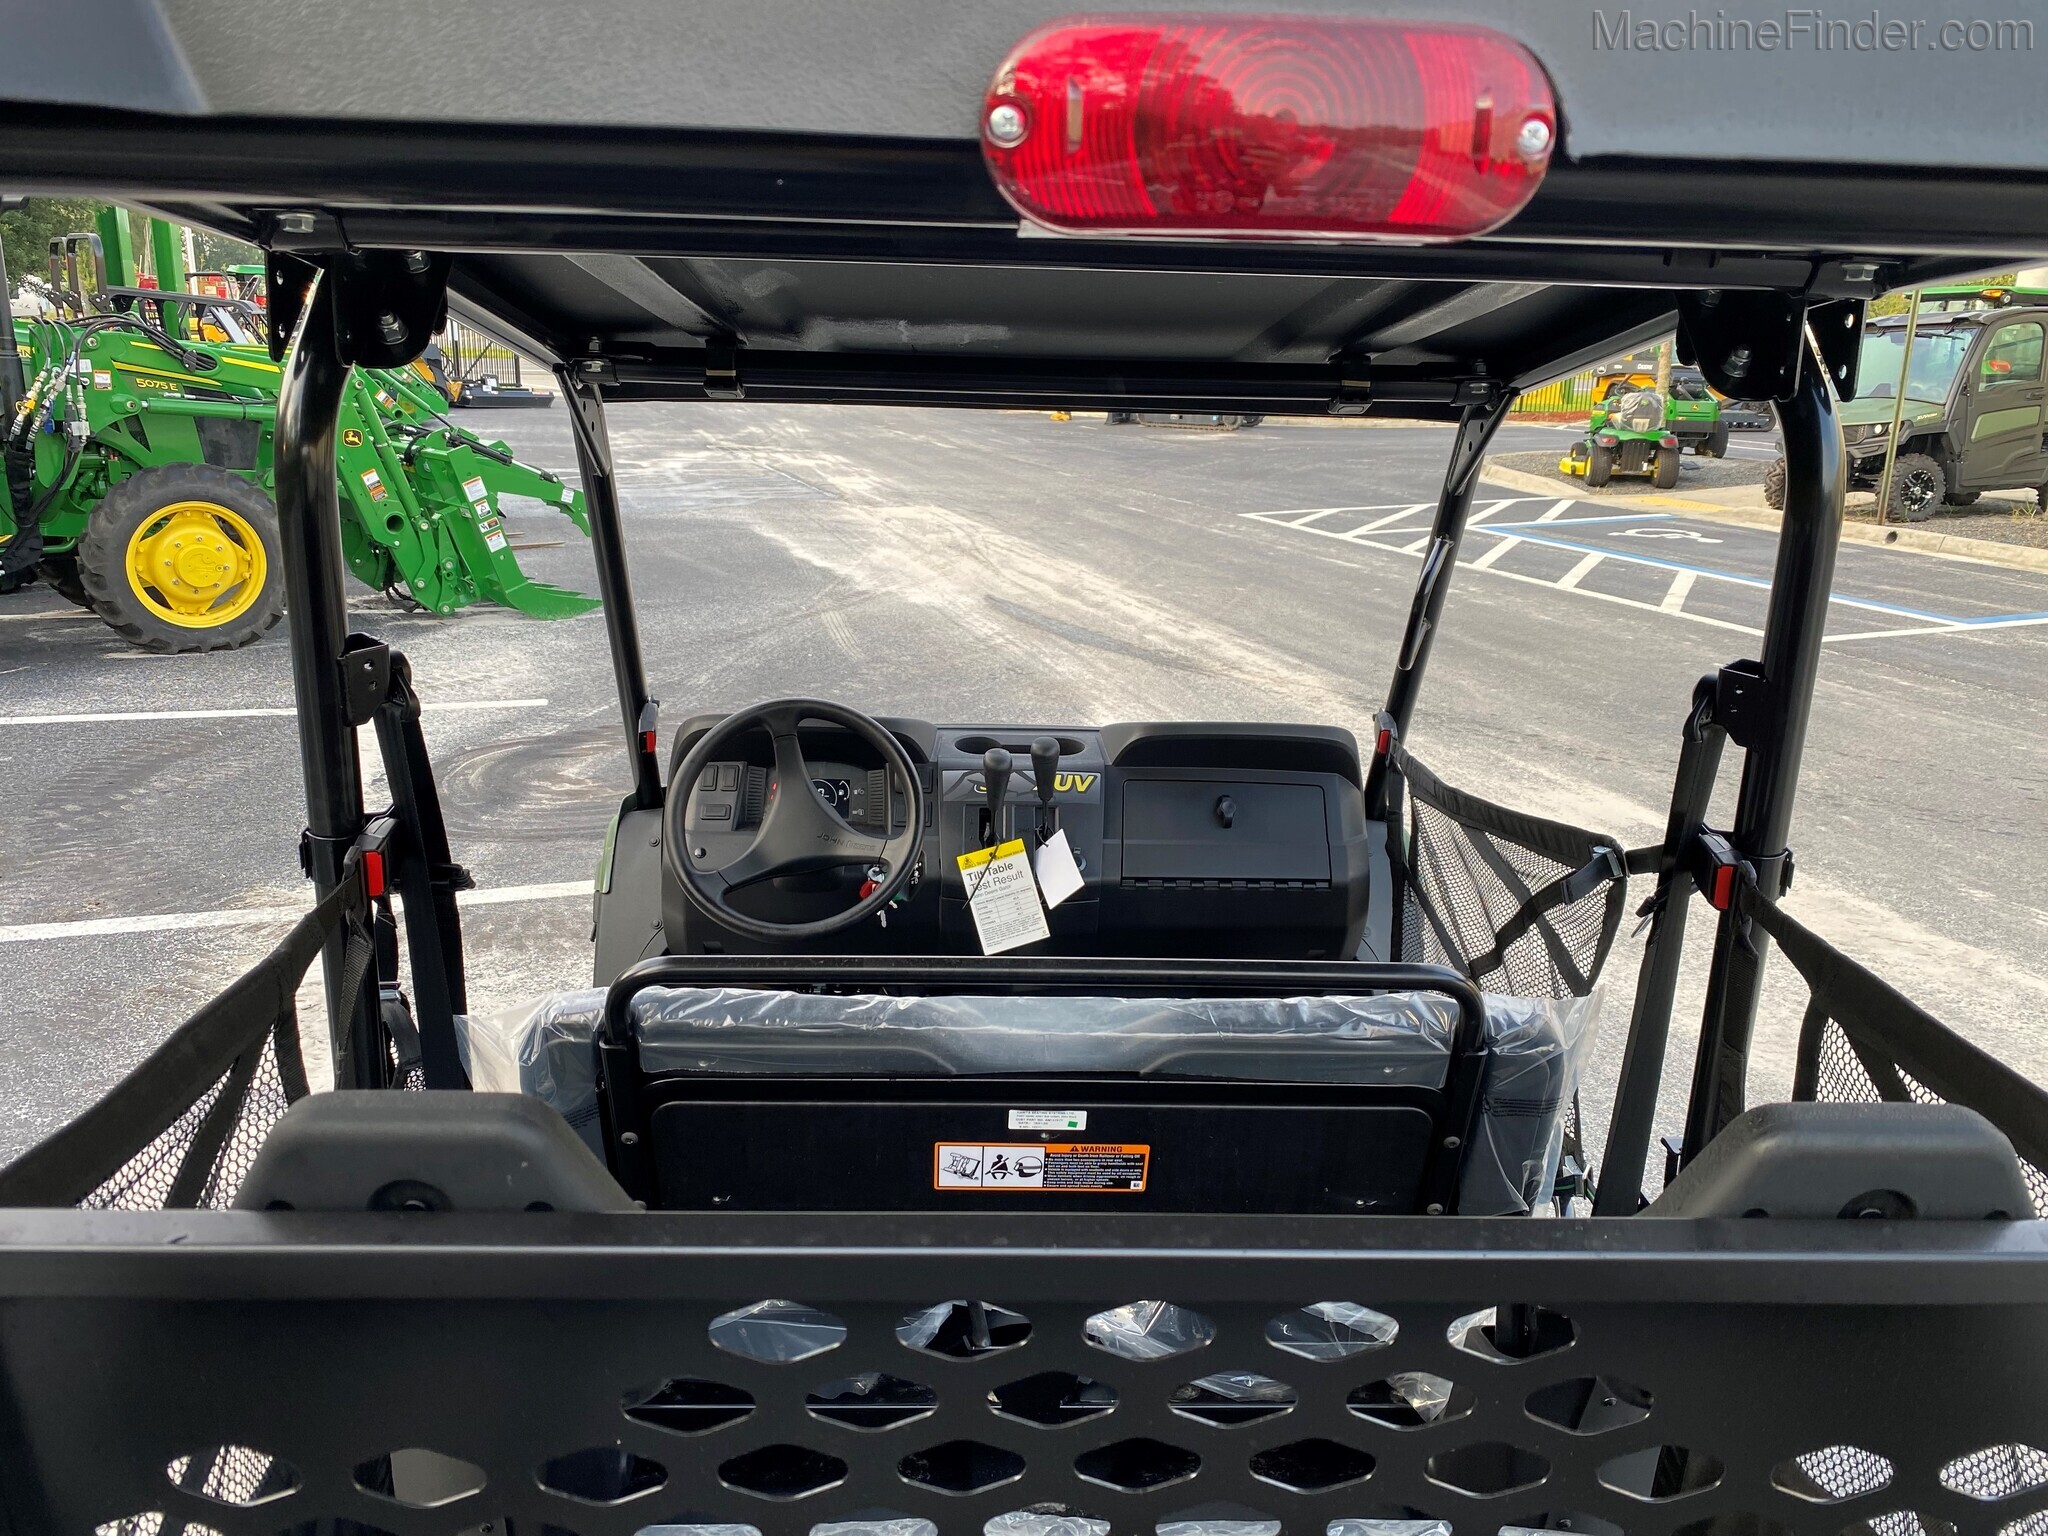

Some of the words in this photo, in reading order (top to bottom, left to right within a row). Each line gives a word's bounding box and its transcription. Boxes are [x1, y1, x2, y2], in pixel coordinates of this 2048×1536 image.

[135, 377, 169, 390] 5075
[169, 382, 179, 391] E
[817, 832, 844, 846] JOHN
[966, 870, 984, 882] Tilt
[986, 861, 1014, 877] Table
[970, 880, 991, 892] Test
[993, 870, 1024, 887] Result
[1080, 1145, 1123, 1153] WARNING
